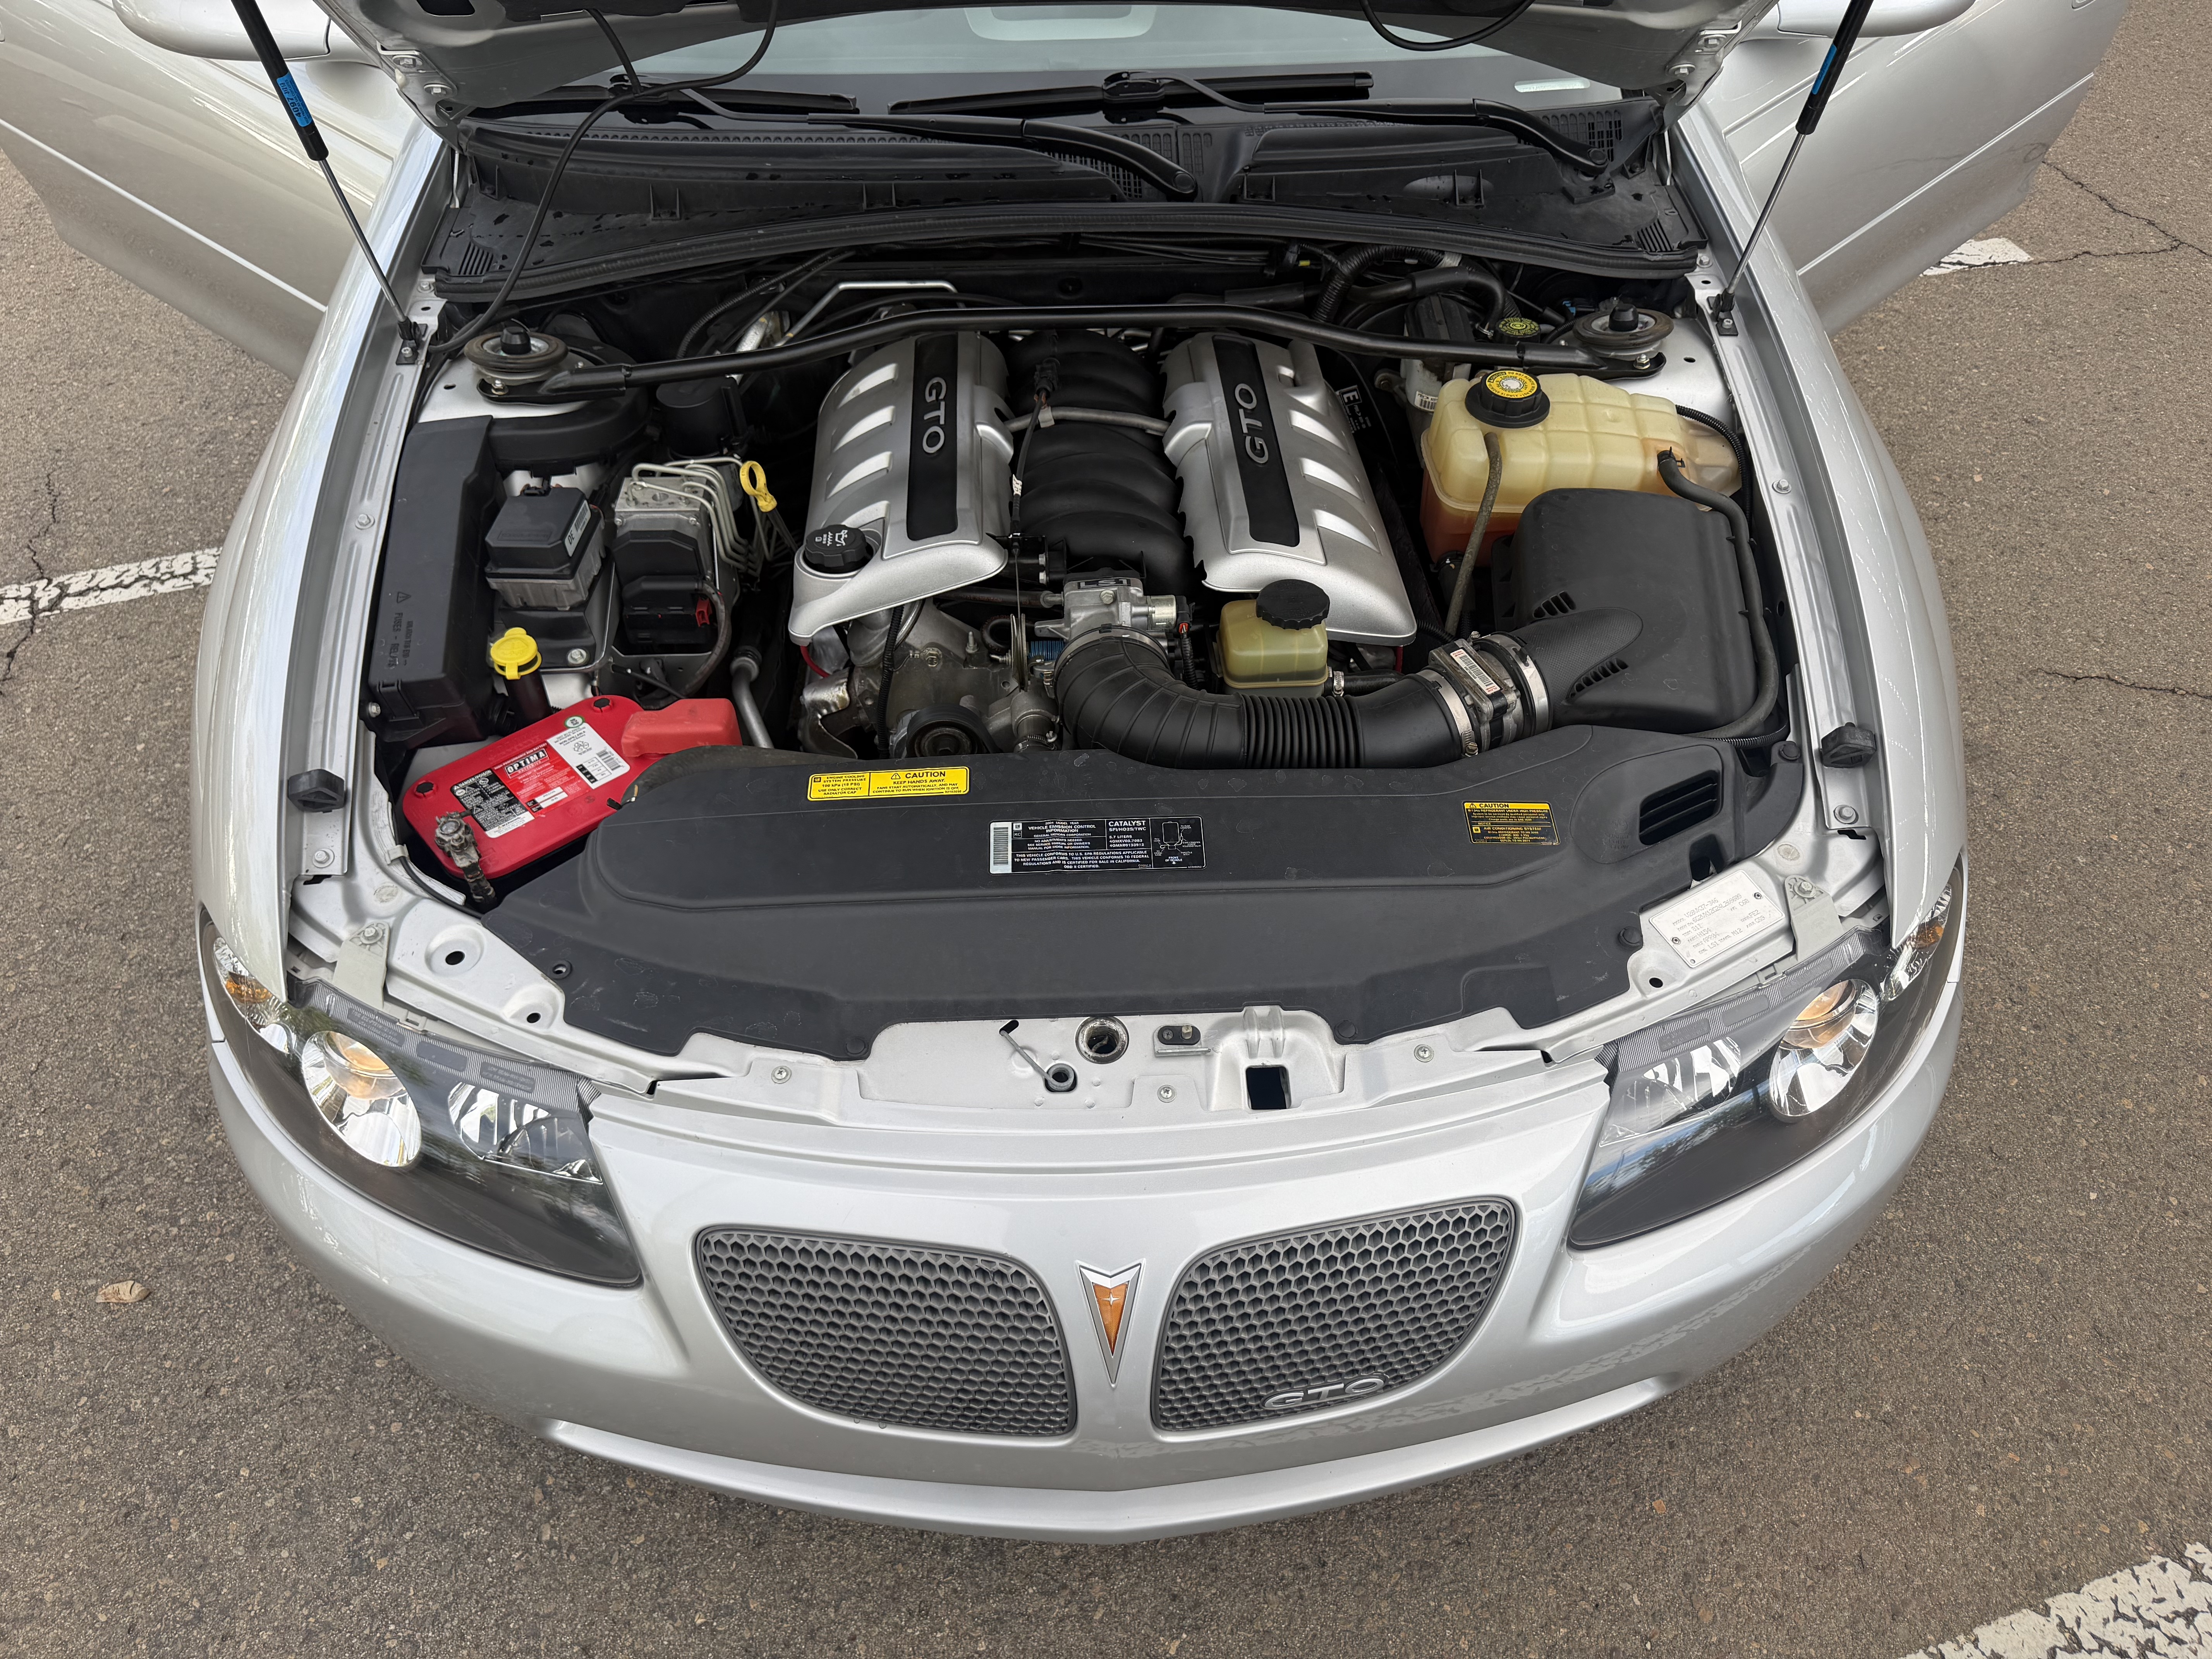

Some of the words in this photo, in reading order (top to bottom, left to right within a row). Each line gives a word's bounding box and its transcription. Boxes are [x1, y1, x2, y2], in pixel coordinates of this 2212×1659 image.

[286, 95, 302, 118] 4097
[1343, 390, 1358, 403] E
[922, 377, 946, 453] GTO
[1234, 383, 1268, 464] GTO
[568, 531, 575, 545] DE
[1080, 579, 1127, 589] LS1
[392, 611, 403, 632] FUSES
[507, 751, 545, 773] OPTIMA
[459, 769, 492, 788] DANGER/POISON
[1748, 910, 1760, 918] FE2
[1264, 1378, 1384, 1407] GTO
